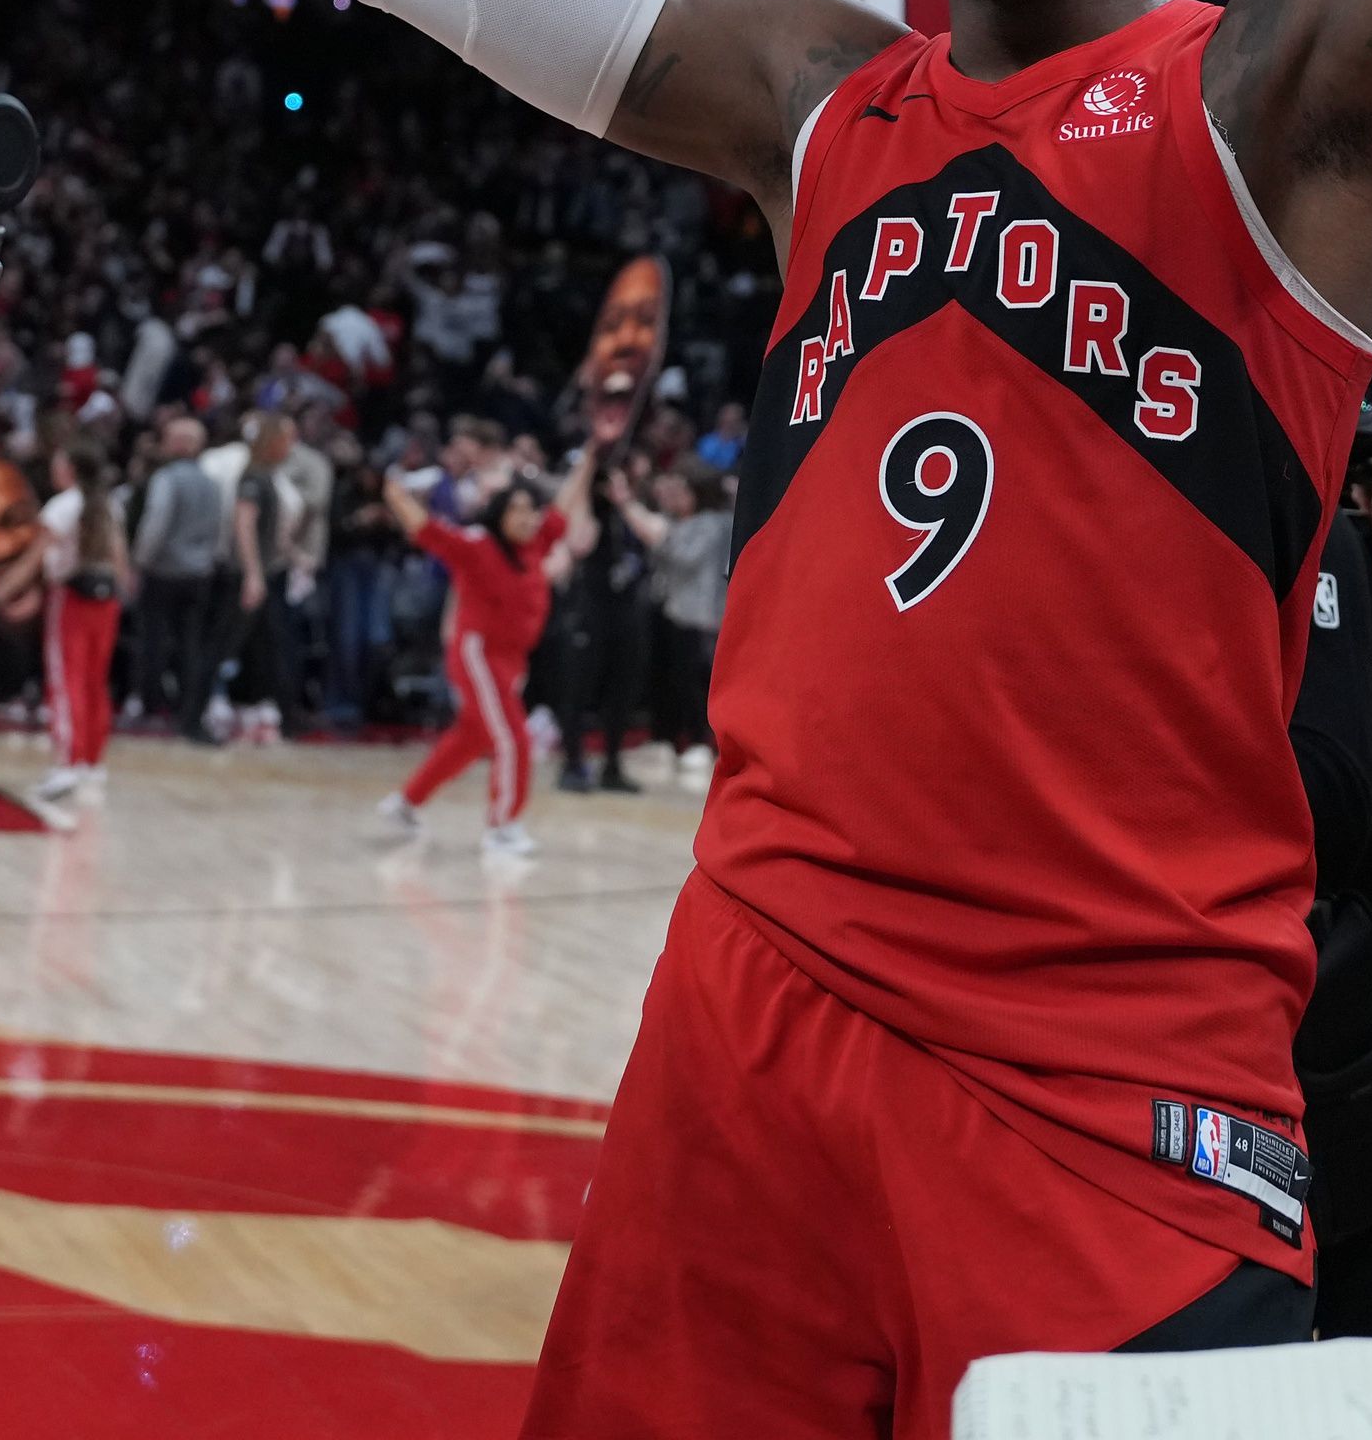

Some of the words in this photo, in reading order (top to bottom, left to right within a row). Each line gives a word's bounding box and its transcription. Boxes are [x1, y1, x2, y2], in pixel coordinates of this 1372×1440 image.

[1059, 123, 1105, 141] Sun
[1111, 112, 1154, 135] Life
[790, 190, 1202, 443] RAPTORS
[877, 410, 995, 613] 9
[1234, 1137, 1249, 1153] 48
